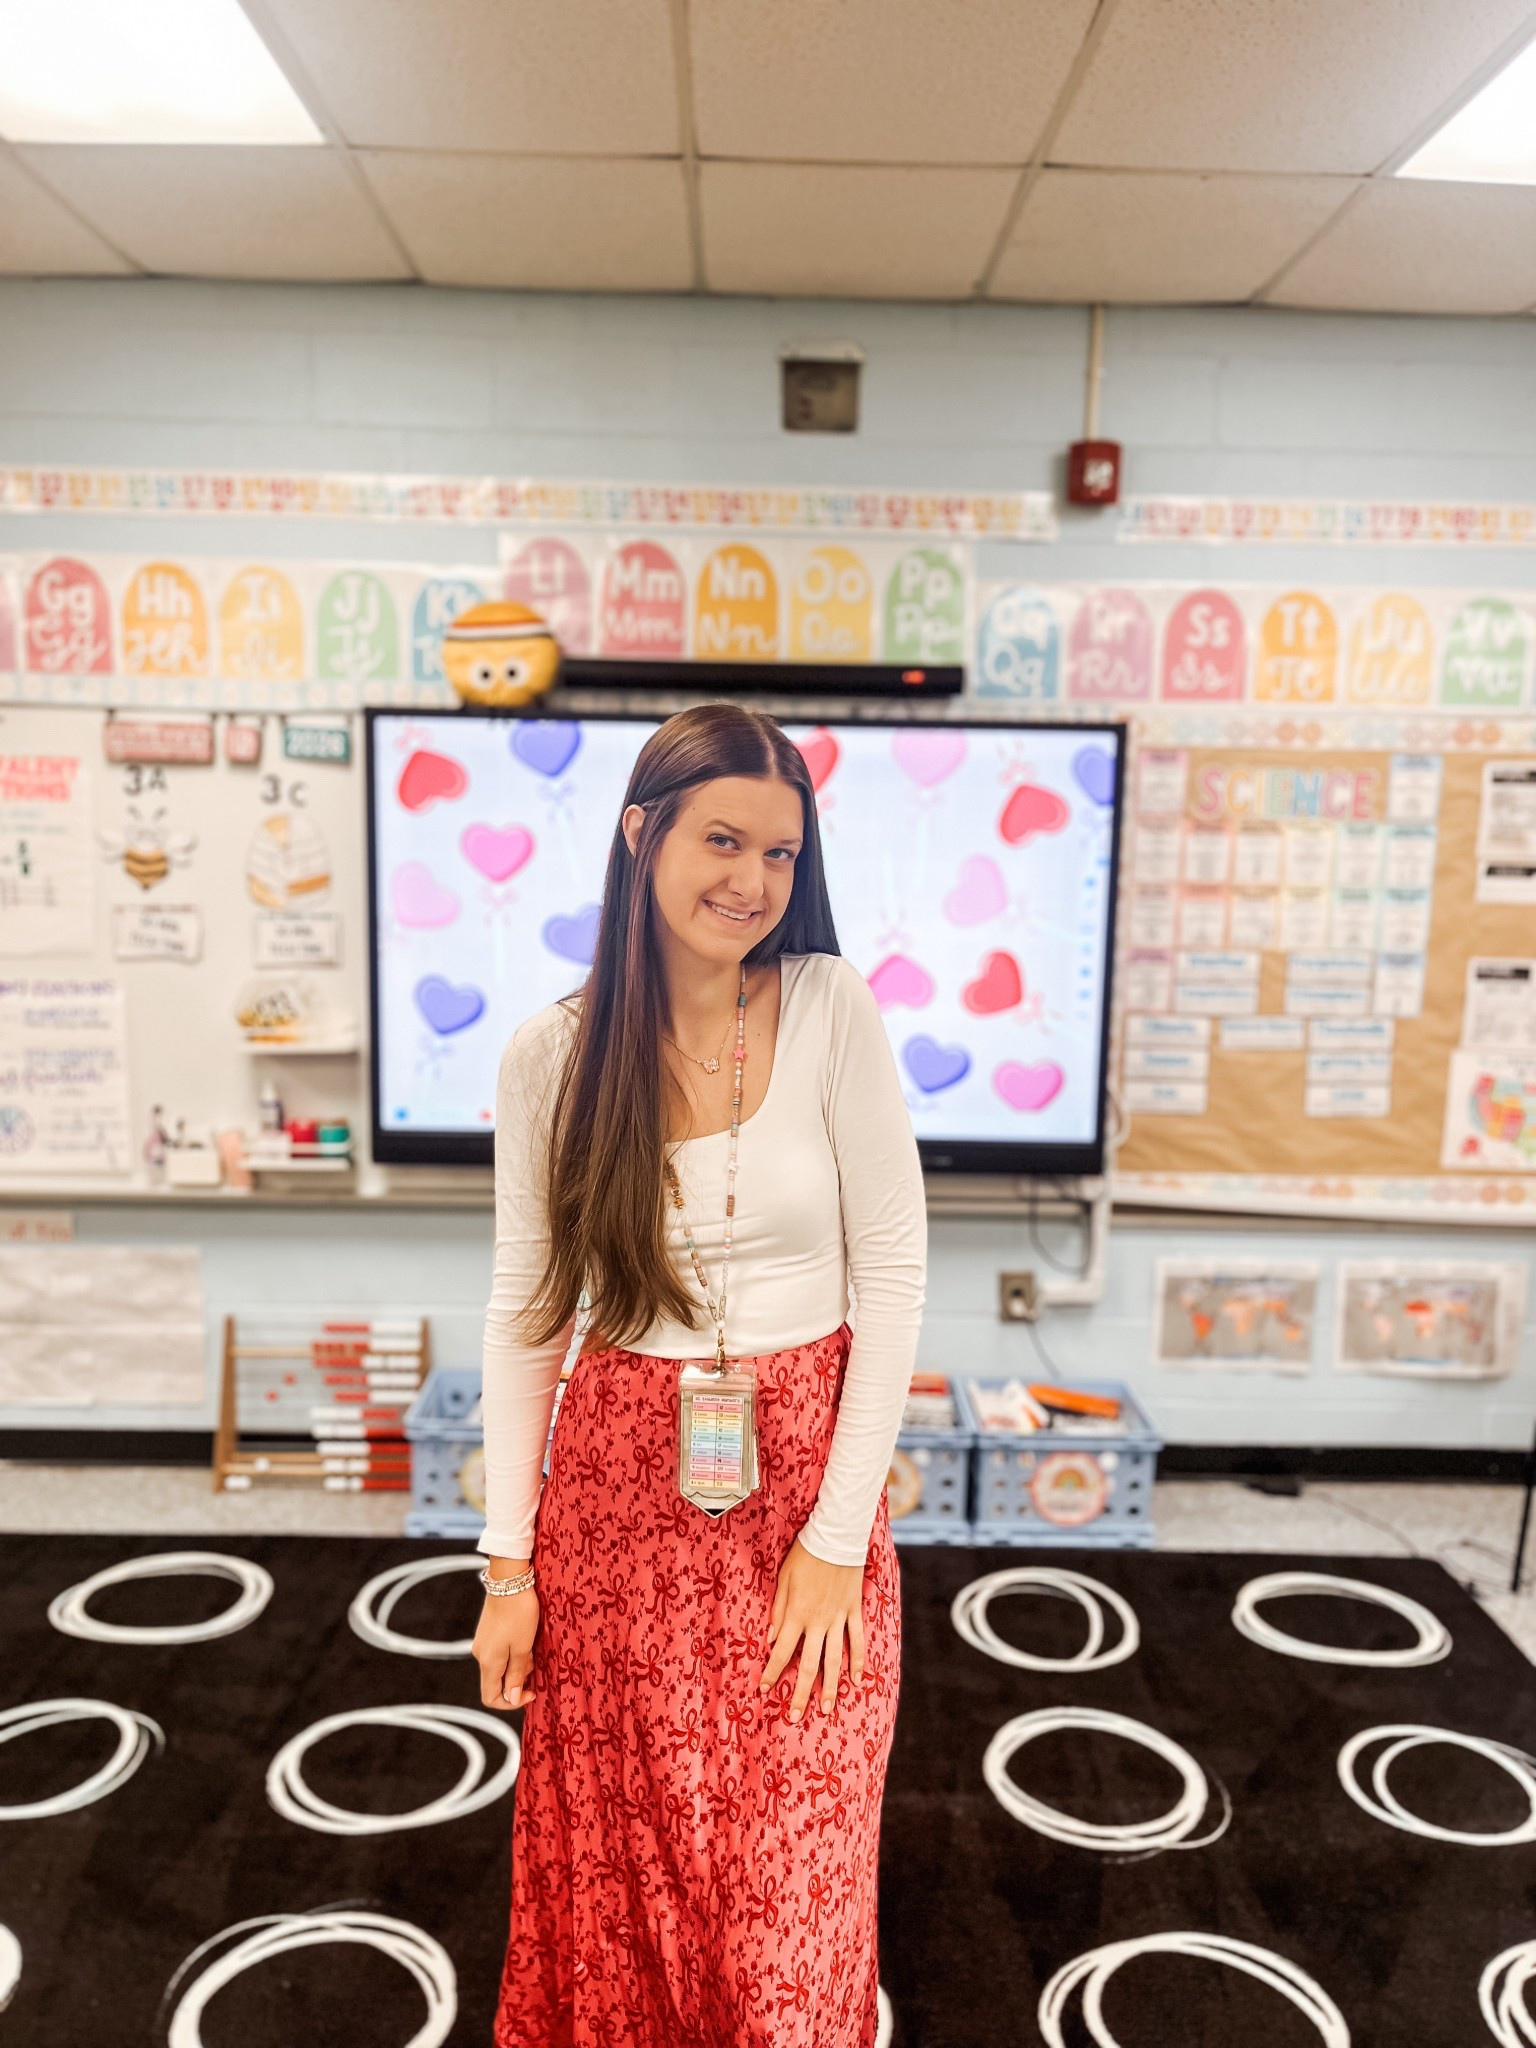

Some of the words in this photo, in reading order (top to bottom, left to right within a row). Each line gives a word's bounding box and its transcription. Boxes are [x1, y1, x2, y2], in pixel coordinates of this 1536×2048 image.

[38, 570, 95, 628] Gg
[138, 574, 193, 617] Hh
[612, 555, 682, 601] Mm
[711, 554, 766, 601] Nn
[800, 556, 867, 605] Oo
[902, 556, 950, 613] Pp
[1184, 602, 1231, 648] Ss
[1278, 603, 1322, 649] Tt
[1363, 608, 1424, 654] Uu
[984, 642, 1045, 700] Qq
[1078, 651, 1146, 692] Rr
[0, 755, 80, 783] ALENT
[1198, 767, 1379, 820] SCIENCE
